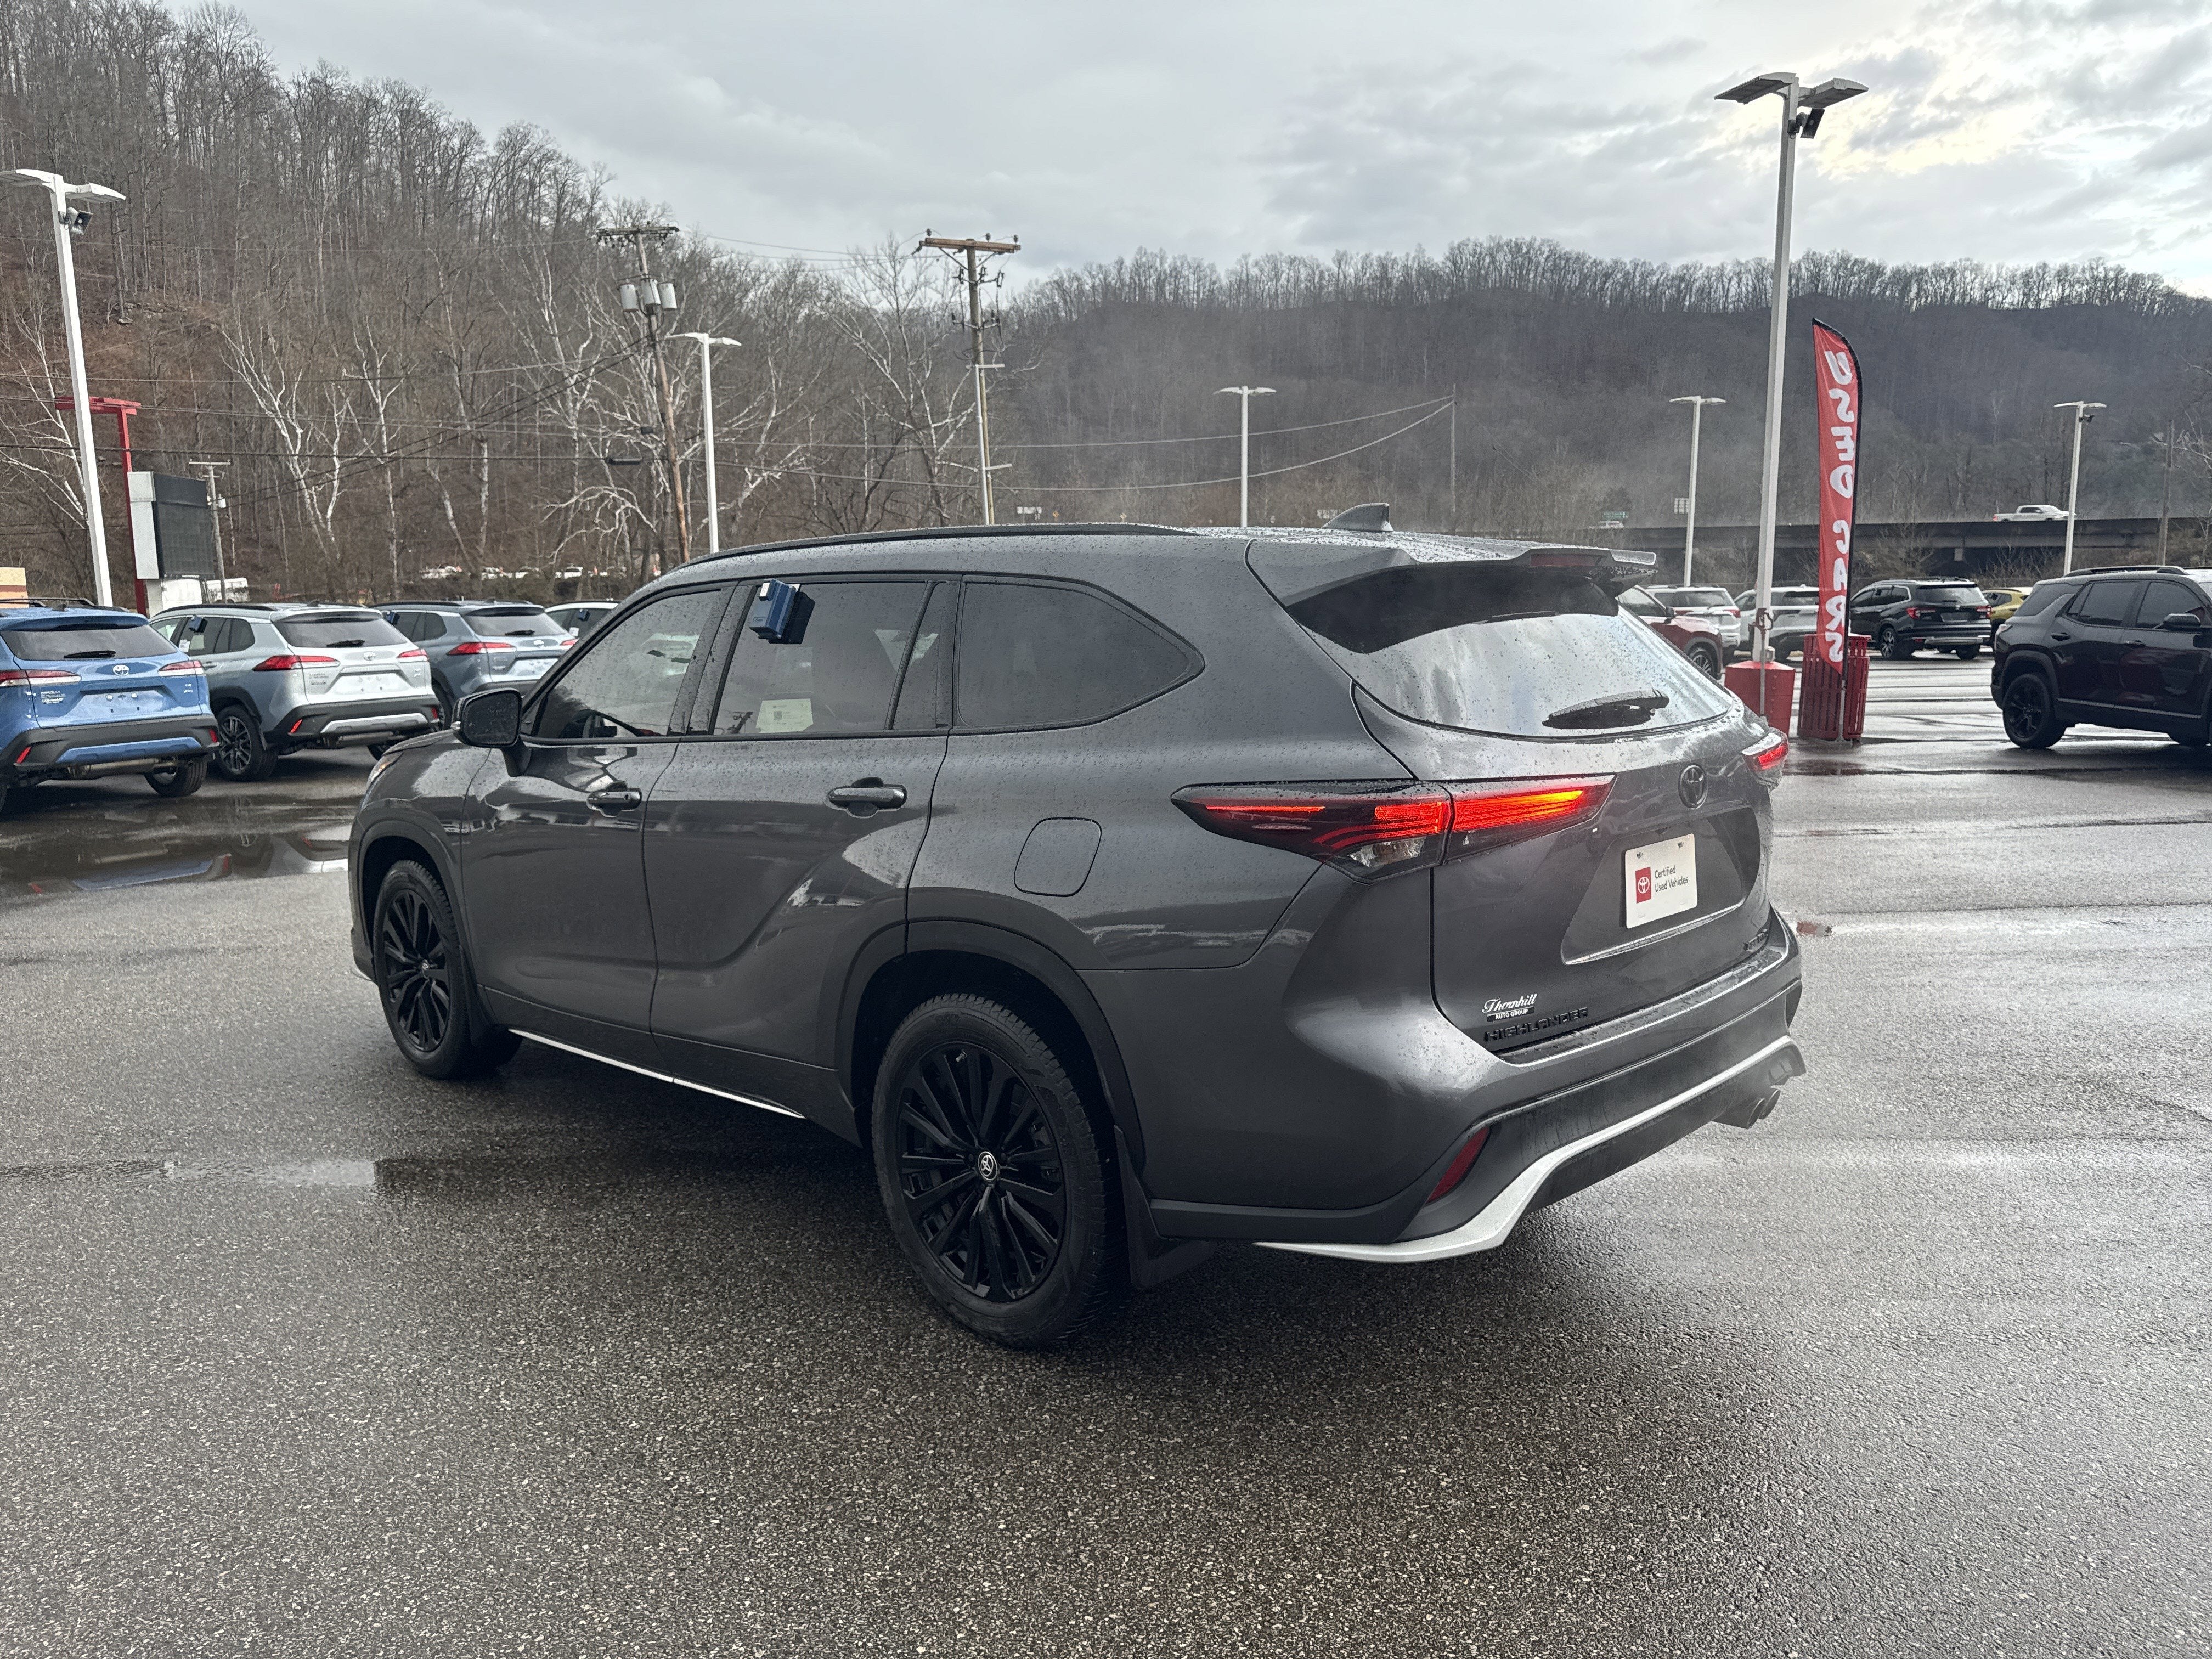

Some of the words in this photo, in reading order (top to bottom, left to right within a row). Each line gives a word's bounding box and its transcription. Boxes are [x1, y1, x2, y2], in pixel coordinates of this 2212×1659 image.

[1655, 865, 1676, 878] Certified
[1655, 880, 1668, 892] Used
[1668, 876, 1688, 888] Vehicles
[1482, 994, 1537, 1013] Thornhill
[1495, 1012, 1510, 1020] AUTO
[1510, 1008, 1528, 1017] GROUP
[1484, 1007, 1589, 1042] HIGHLANDER
